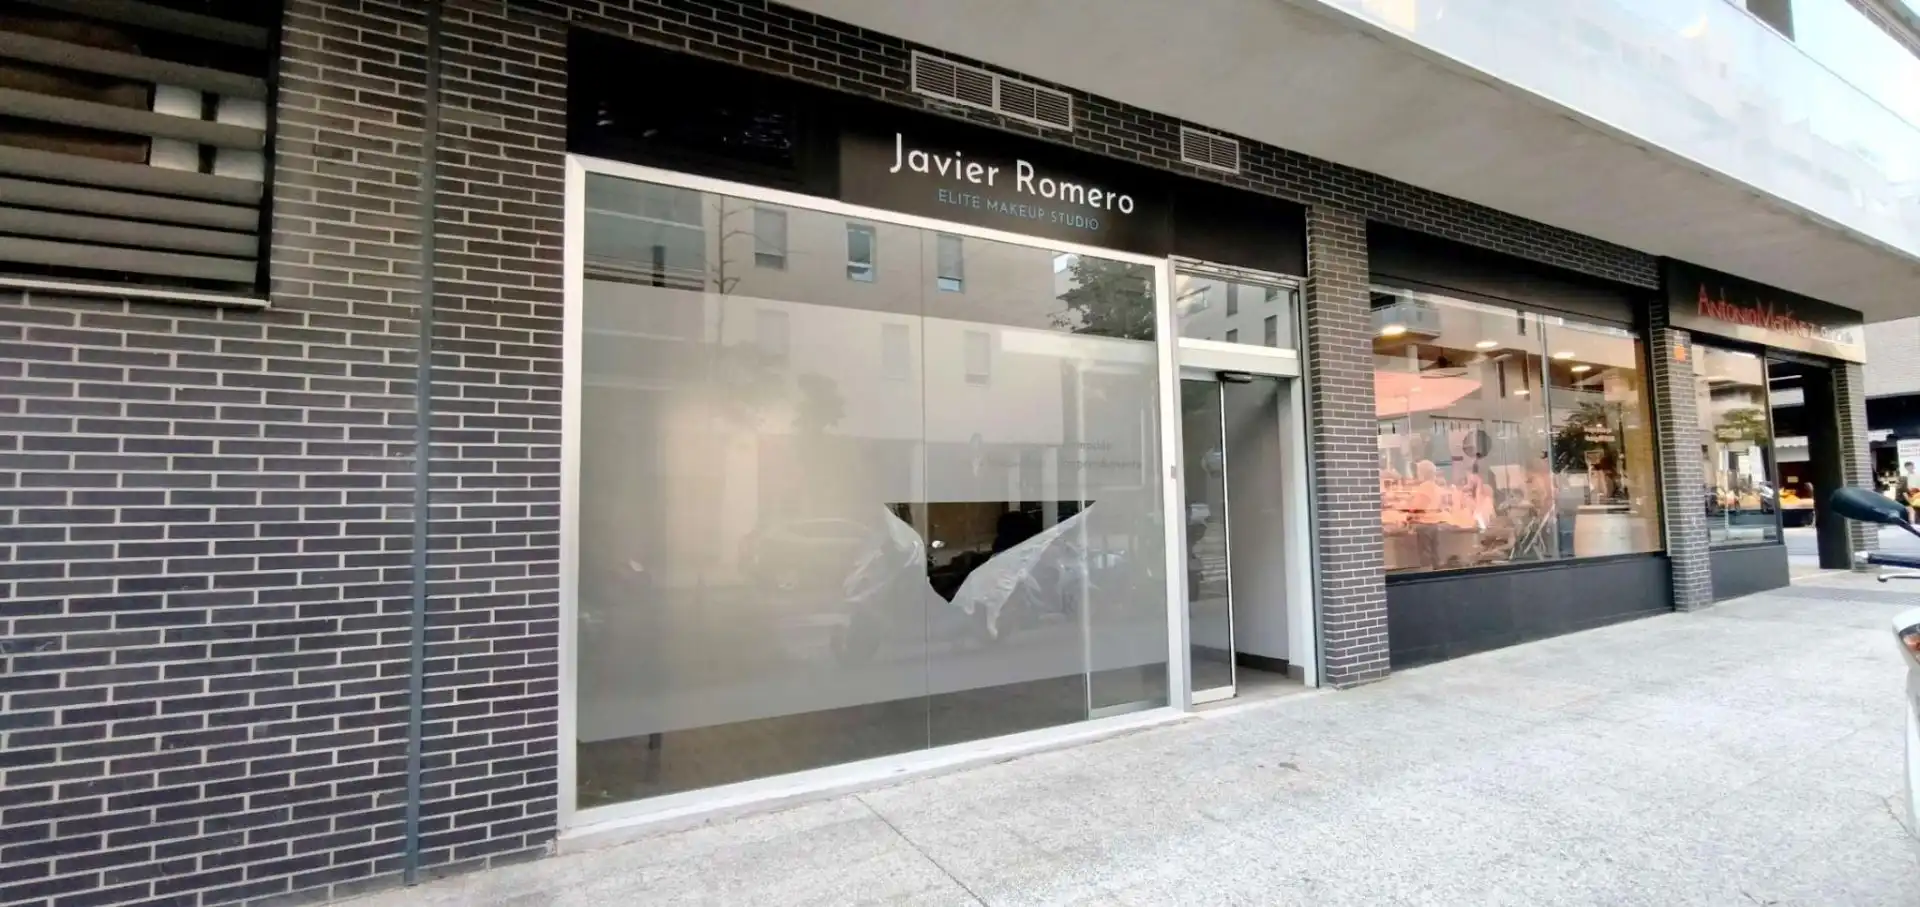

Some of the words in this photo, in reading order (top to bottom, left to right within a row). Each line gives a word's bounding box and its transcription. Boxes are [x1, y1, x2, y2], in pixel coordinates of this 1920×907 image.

[890, 132, 999, 186] Javier
[1016, 159, 1134, 214] Romero
[938, 189, 980, 209] ELITE
[986, 200, 1045, 221] MAKEUP
[1051, 211, 1100, 231] STUDIO
